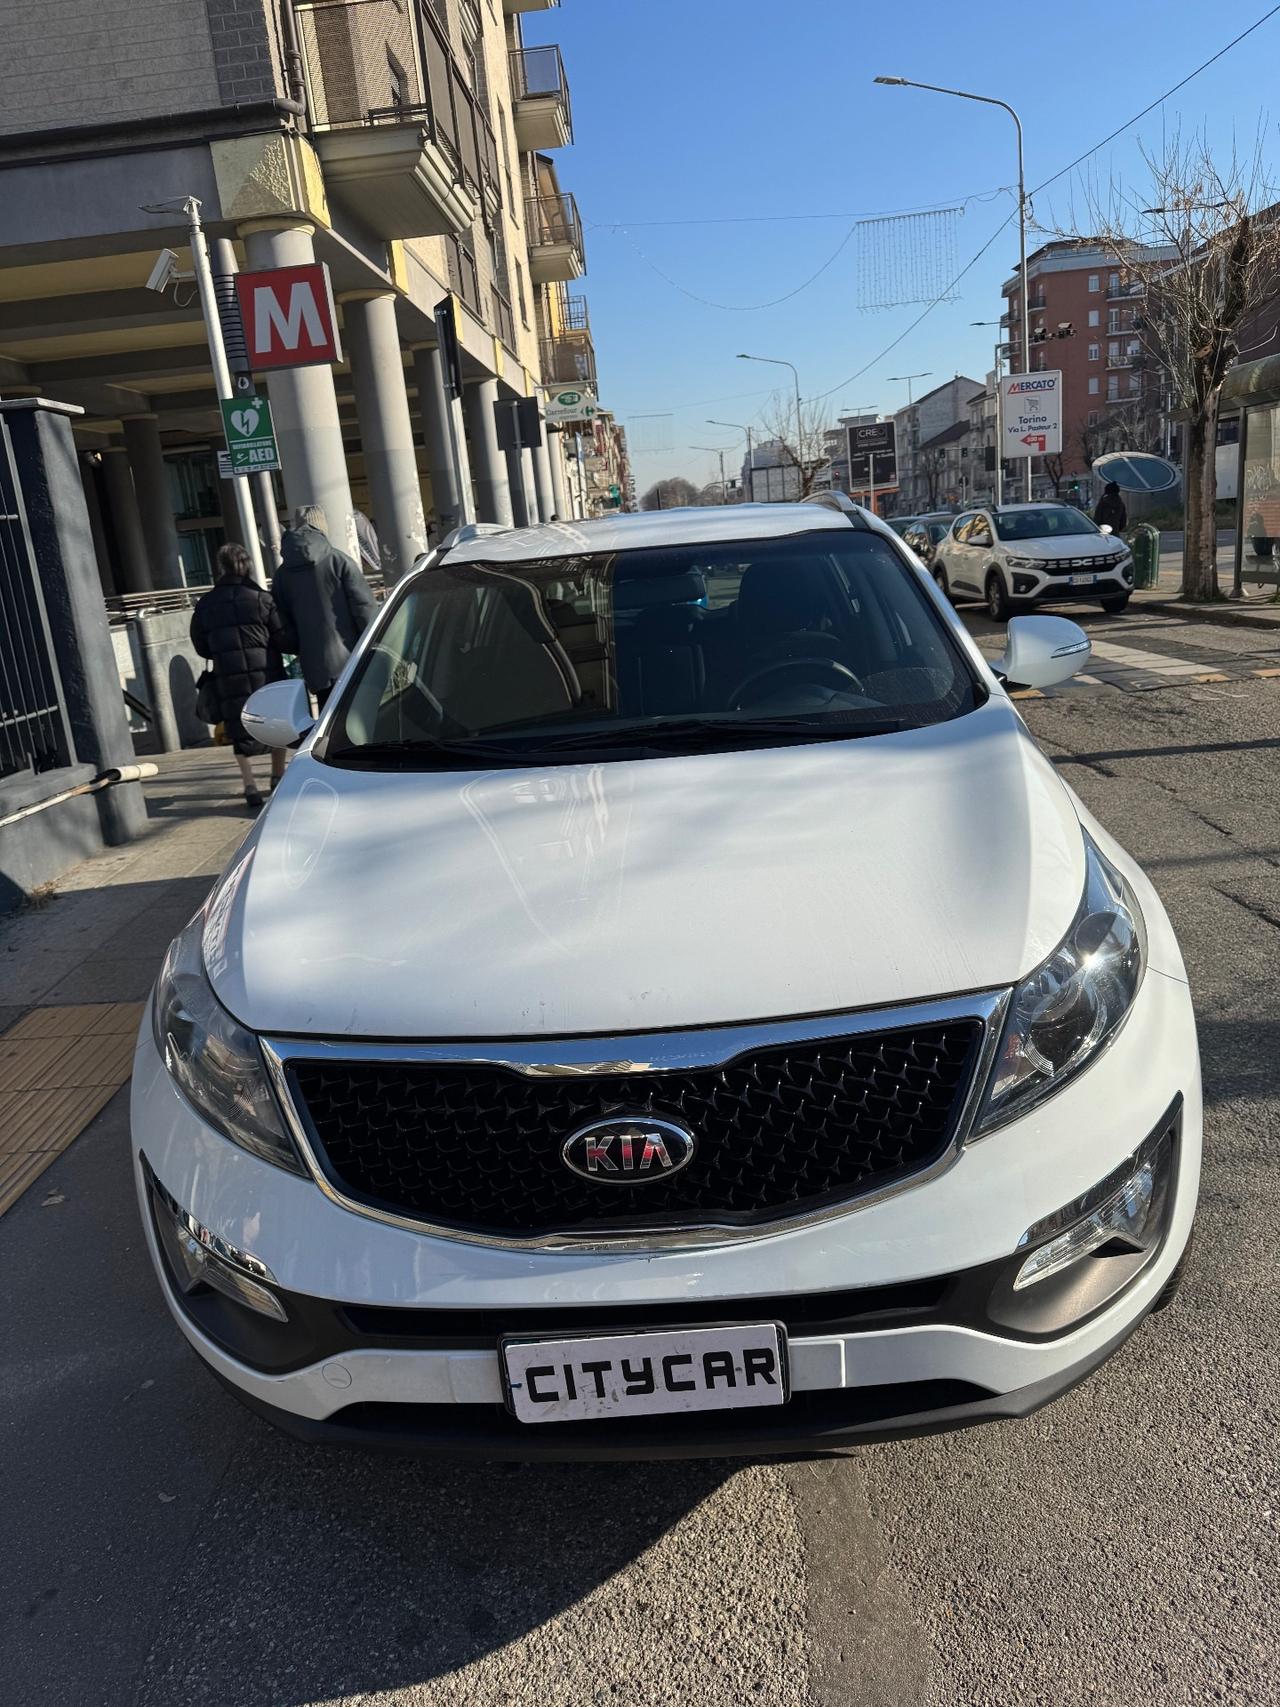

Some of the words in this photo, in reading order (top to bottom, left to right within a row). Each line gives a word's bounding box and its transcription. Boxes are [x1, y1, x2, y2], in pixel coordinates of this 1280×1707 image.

[254, 281, 328, 354] M
[1018, 414, 1047, 425] Torino
[1028, 424, 1051, 432] Pasteur
[248, 447, 275, 463] AED
[584, 1133, 673, 1171] KIA
[525, 1347, 778, 1403] CITYCAR
